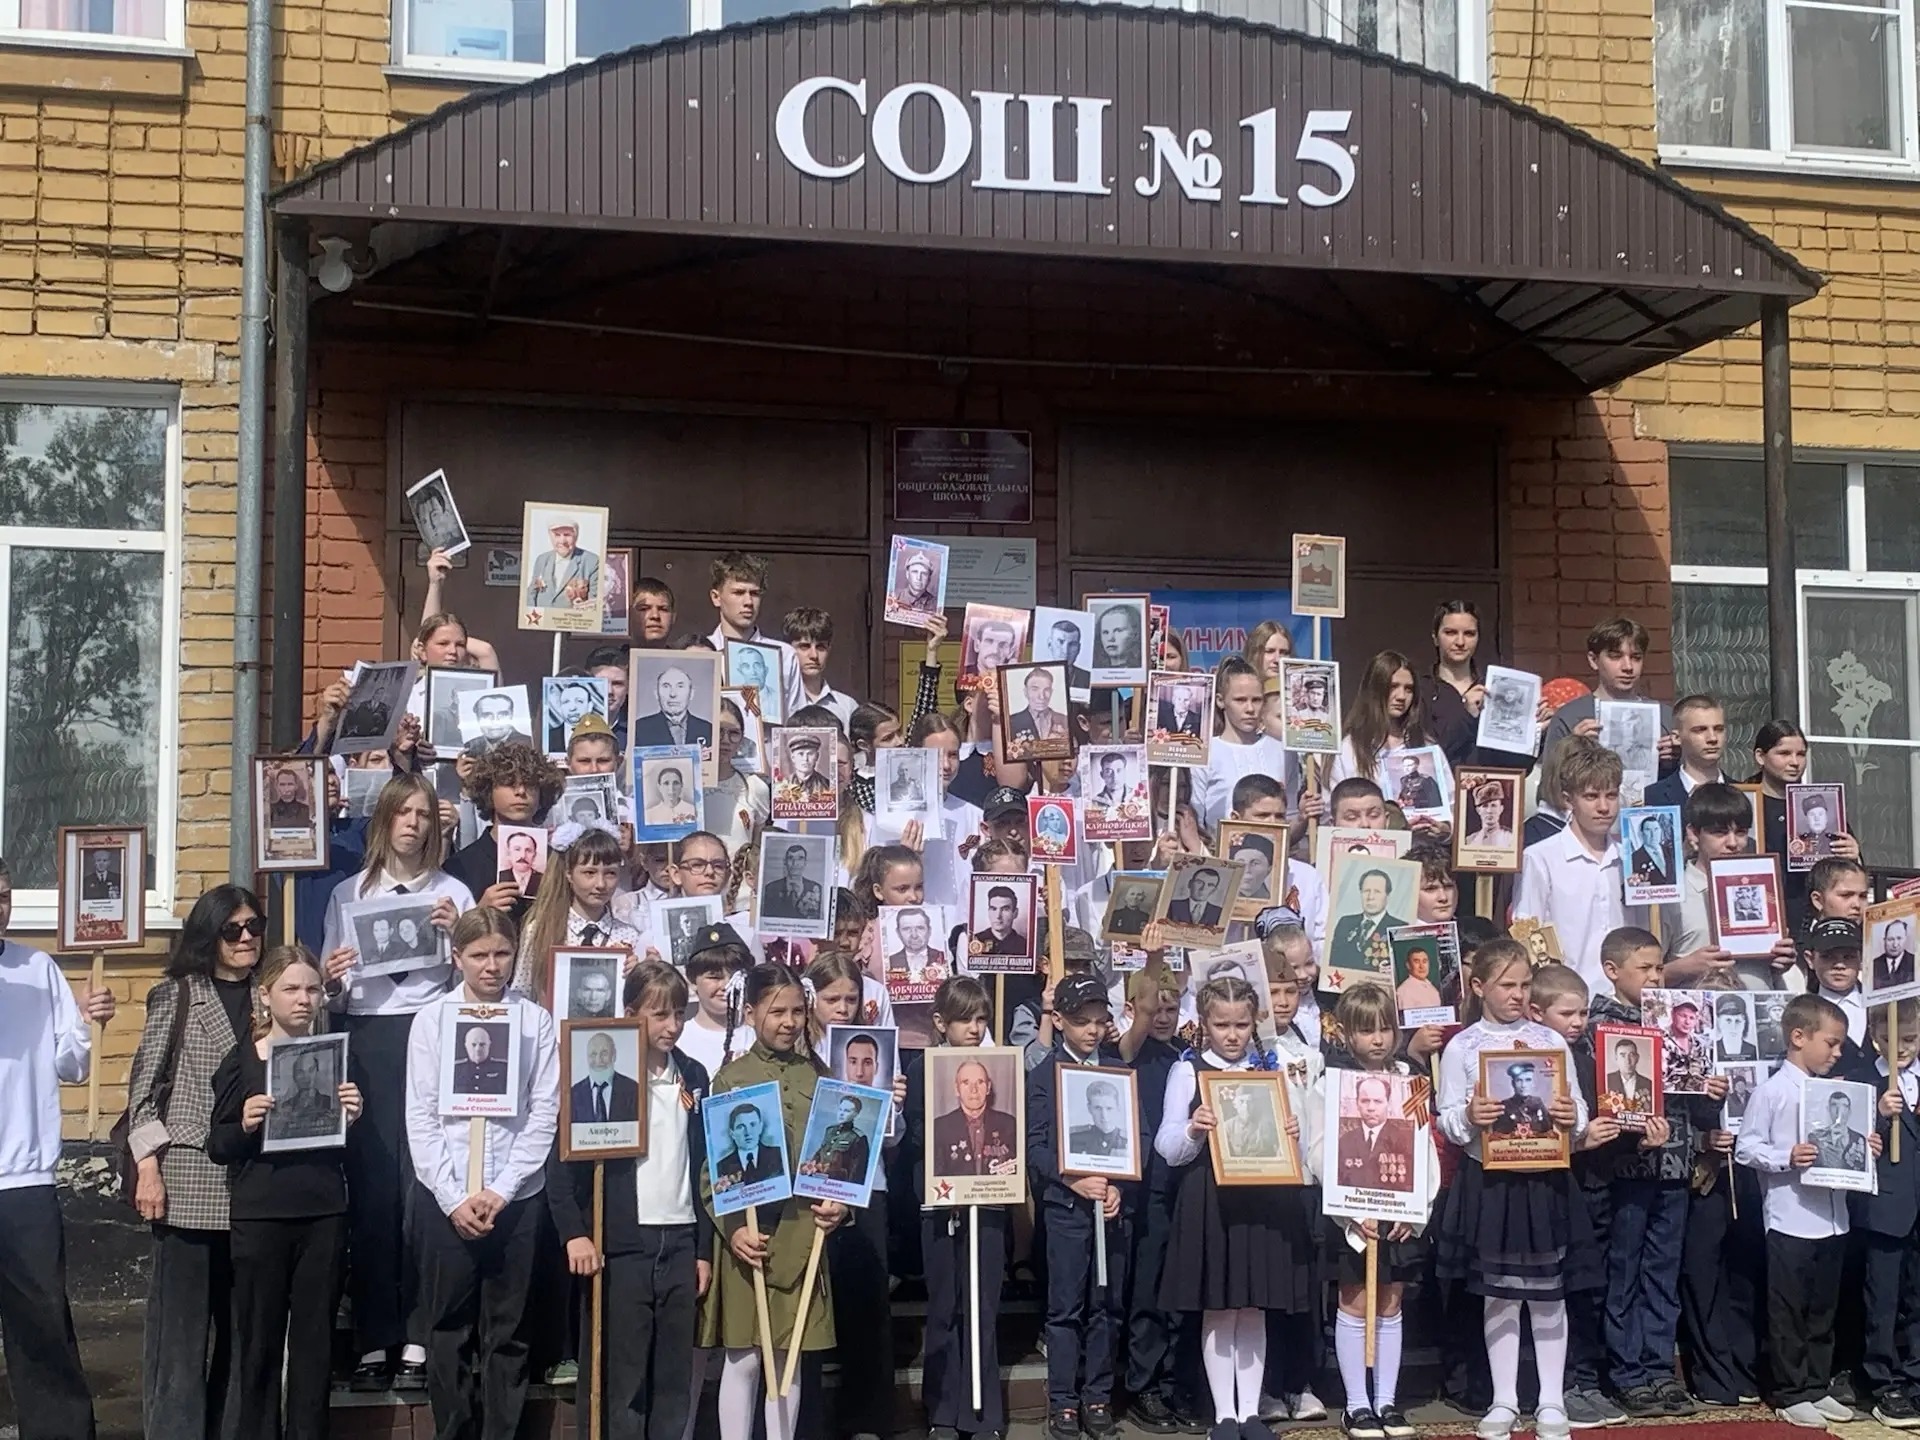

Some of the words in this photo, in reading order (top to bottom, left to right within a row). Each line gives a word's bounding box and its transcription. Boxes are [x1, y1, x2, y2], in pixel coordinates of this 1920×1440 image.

[775, 76, 1112, 194] СОШ
[898, 482, 1029, 493] ОБЩЕОБРАЗОВАТЕЛЬНАЯ
[932, 492, 971, 502] ШКОЛА
[774, 801, 836, 811] ИГНАТОВСКИЙ
[1086, 820, 1149, 830] КЛИНОВИЦКИЙ
[1355, 1188, 1395, 1199] Рымаренко
[1344, 1195, 1366, 1203] Роман
[1367, 1197, 1406, 1208] Макарович
